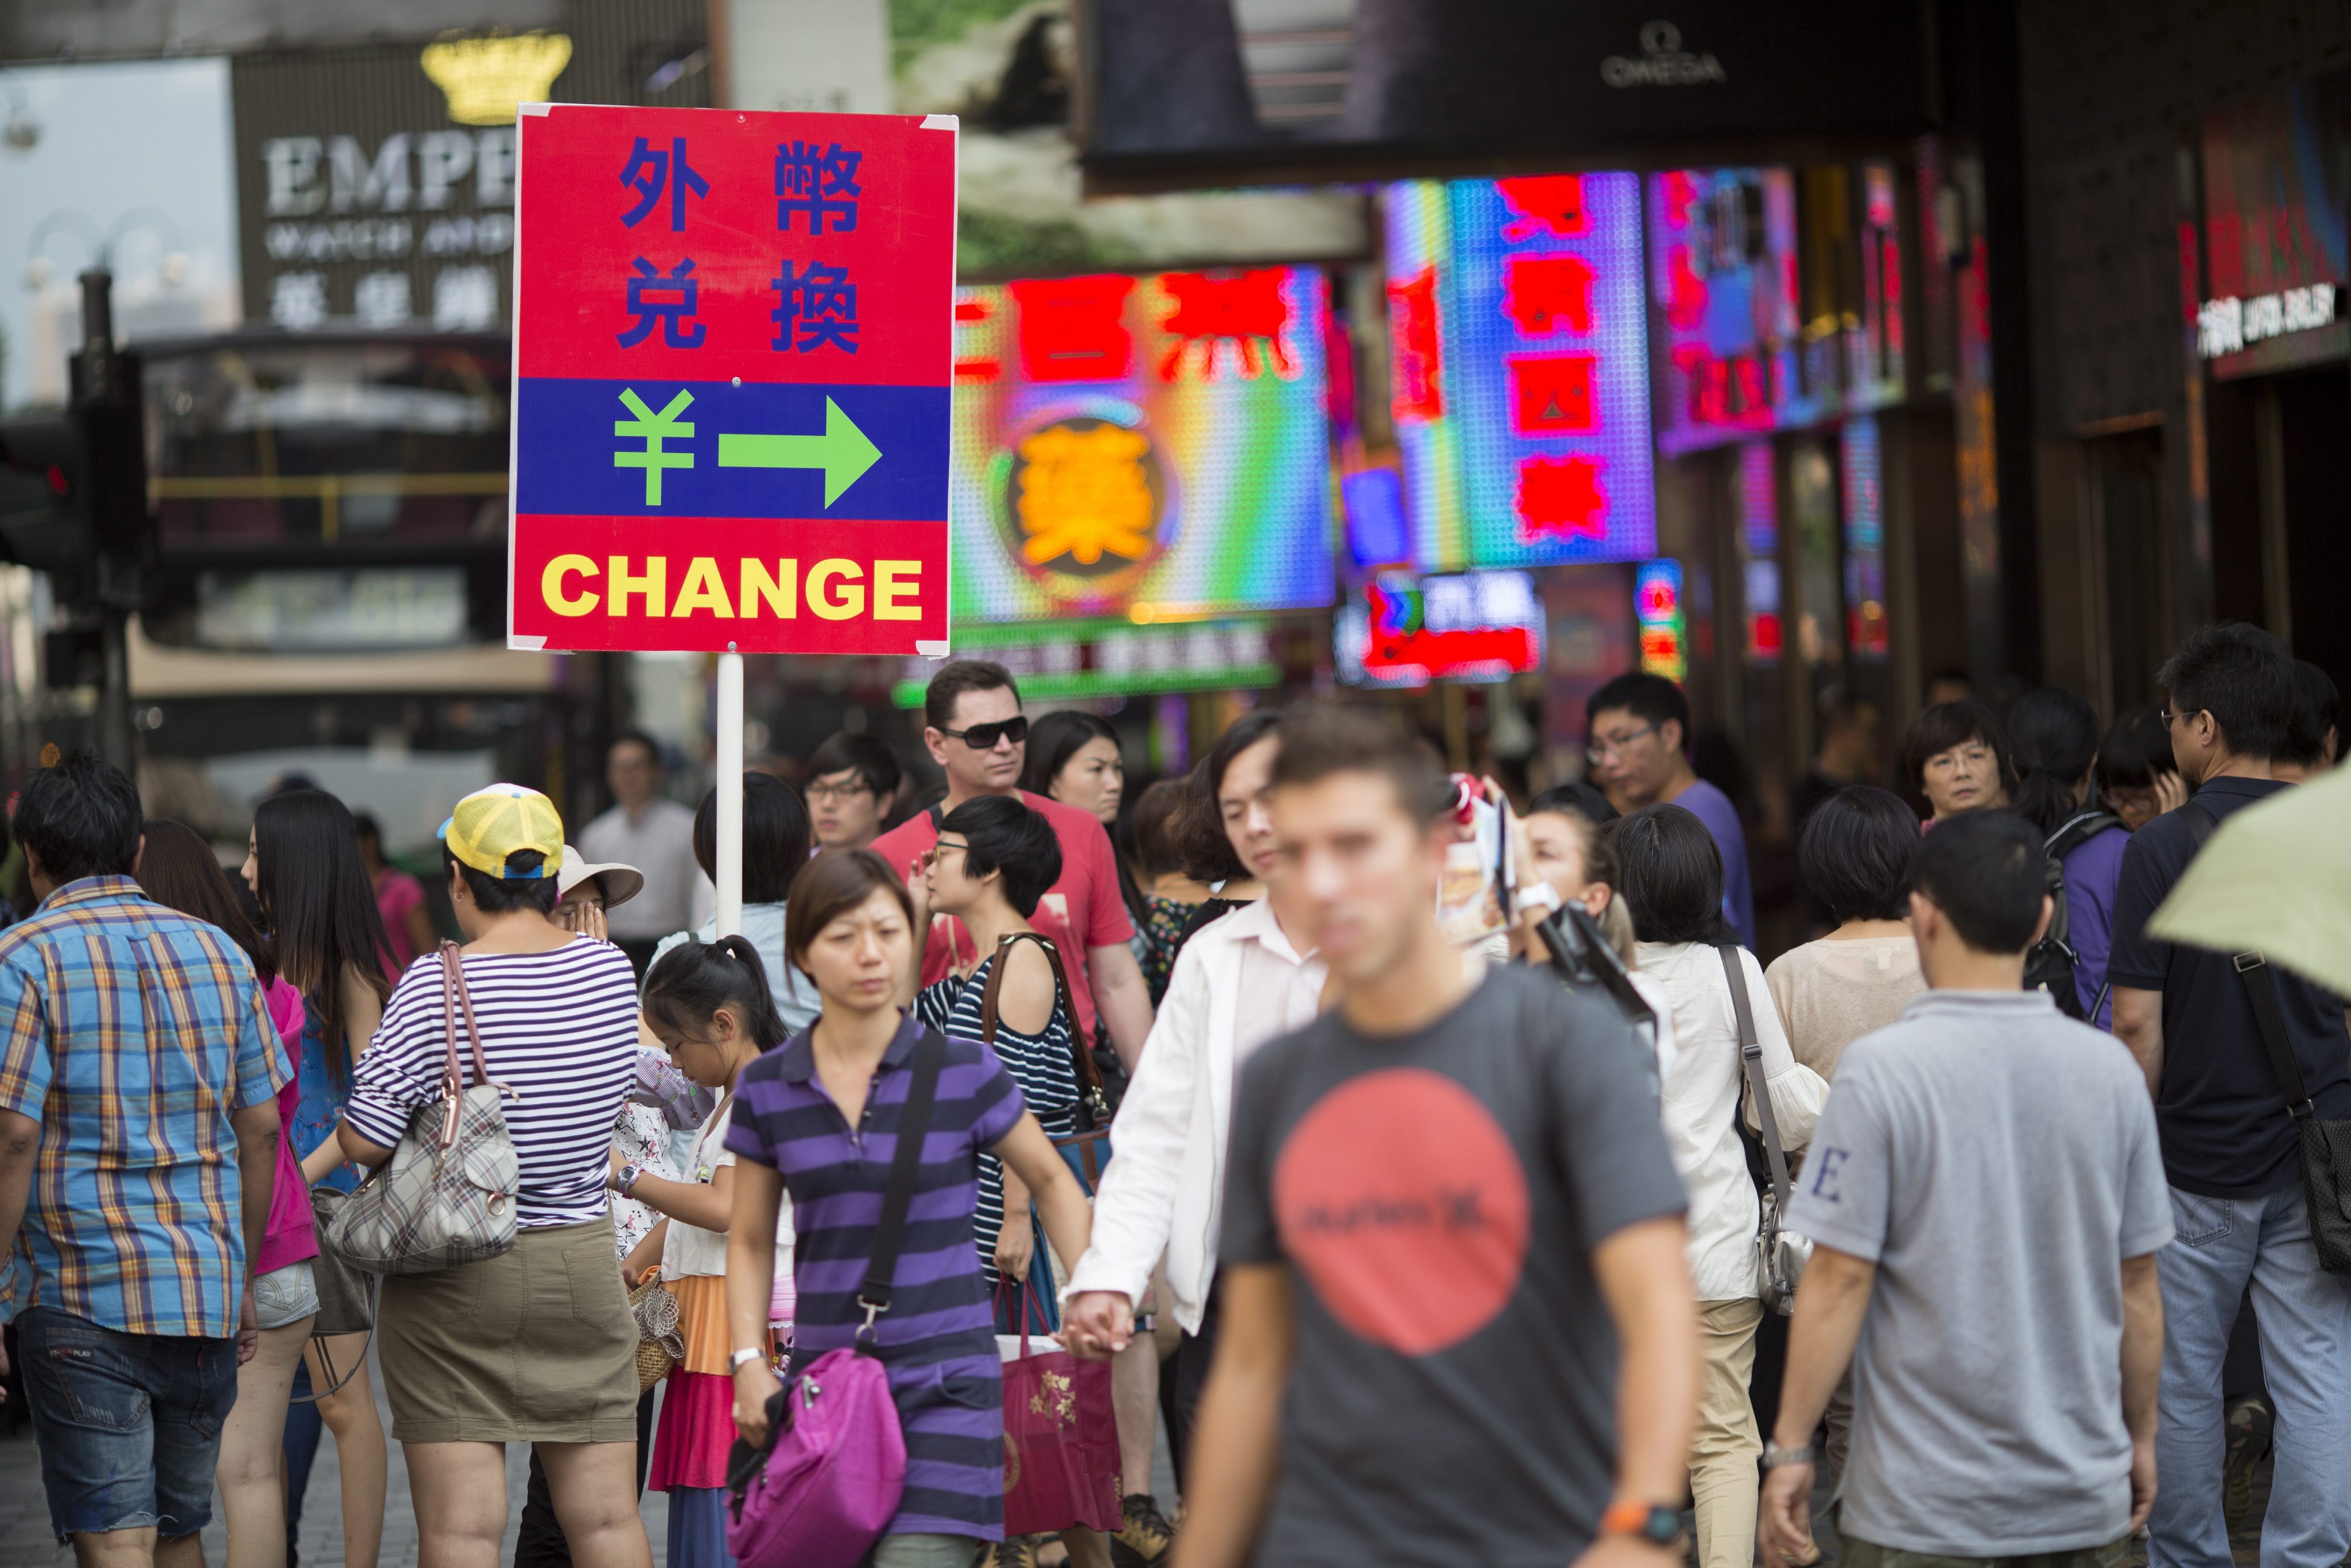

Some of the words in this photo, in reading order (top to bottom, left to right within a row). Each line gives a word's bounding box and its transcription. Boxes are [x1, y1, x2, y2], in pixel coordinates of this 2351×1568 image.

[619, 137, 863, 236] 外幣
[265, 219, 413, 262] WATCH
[421, 214, 514, 257] AND
[541, 554, 922, 621] CHANGE
[1811, 1146, 1851, 1203] E
